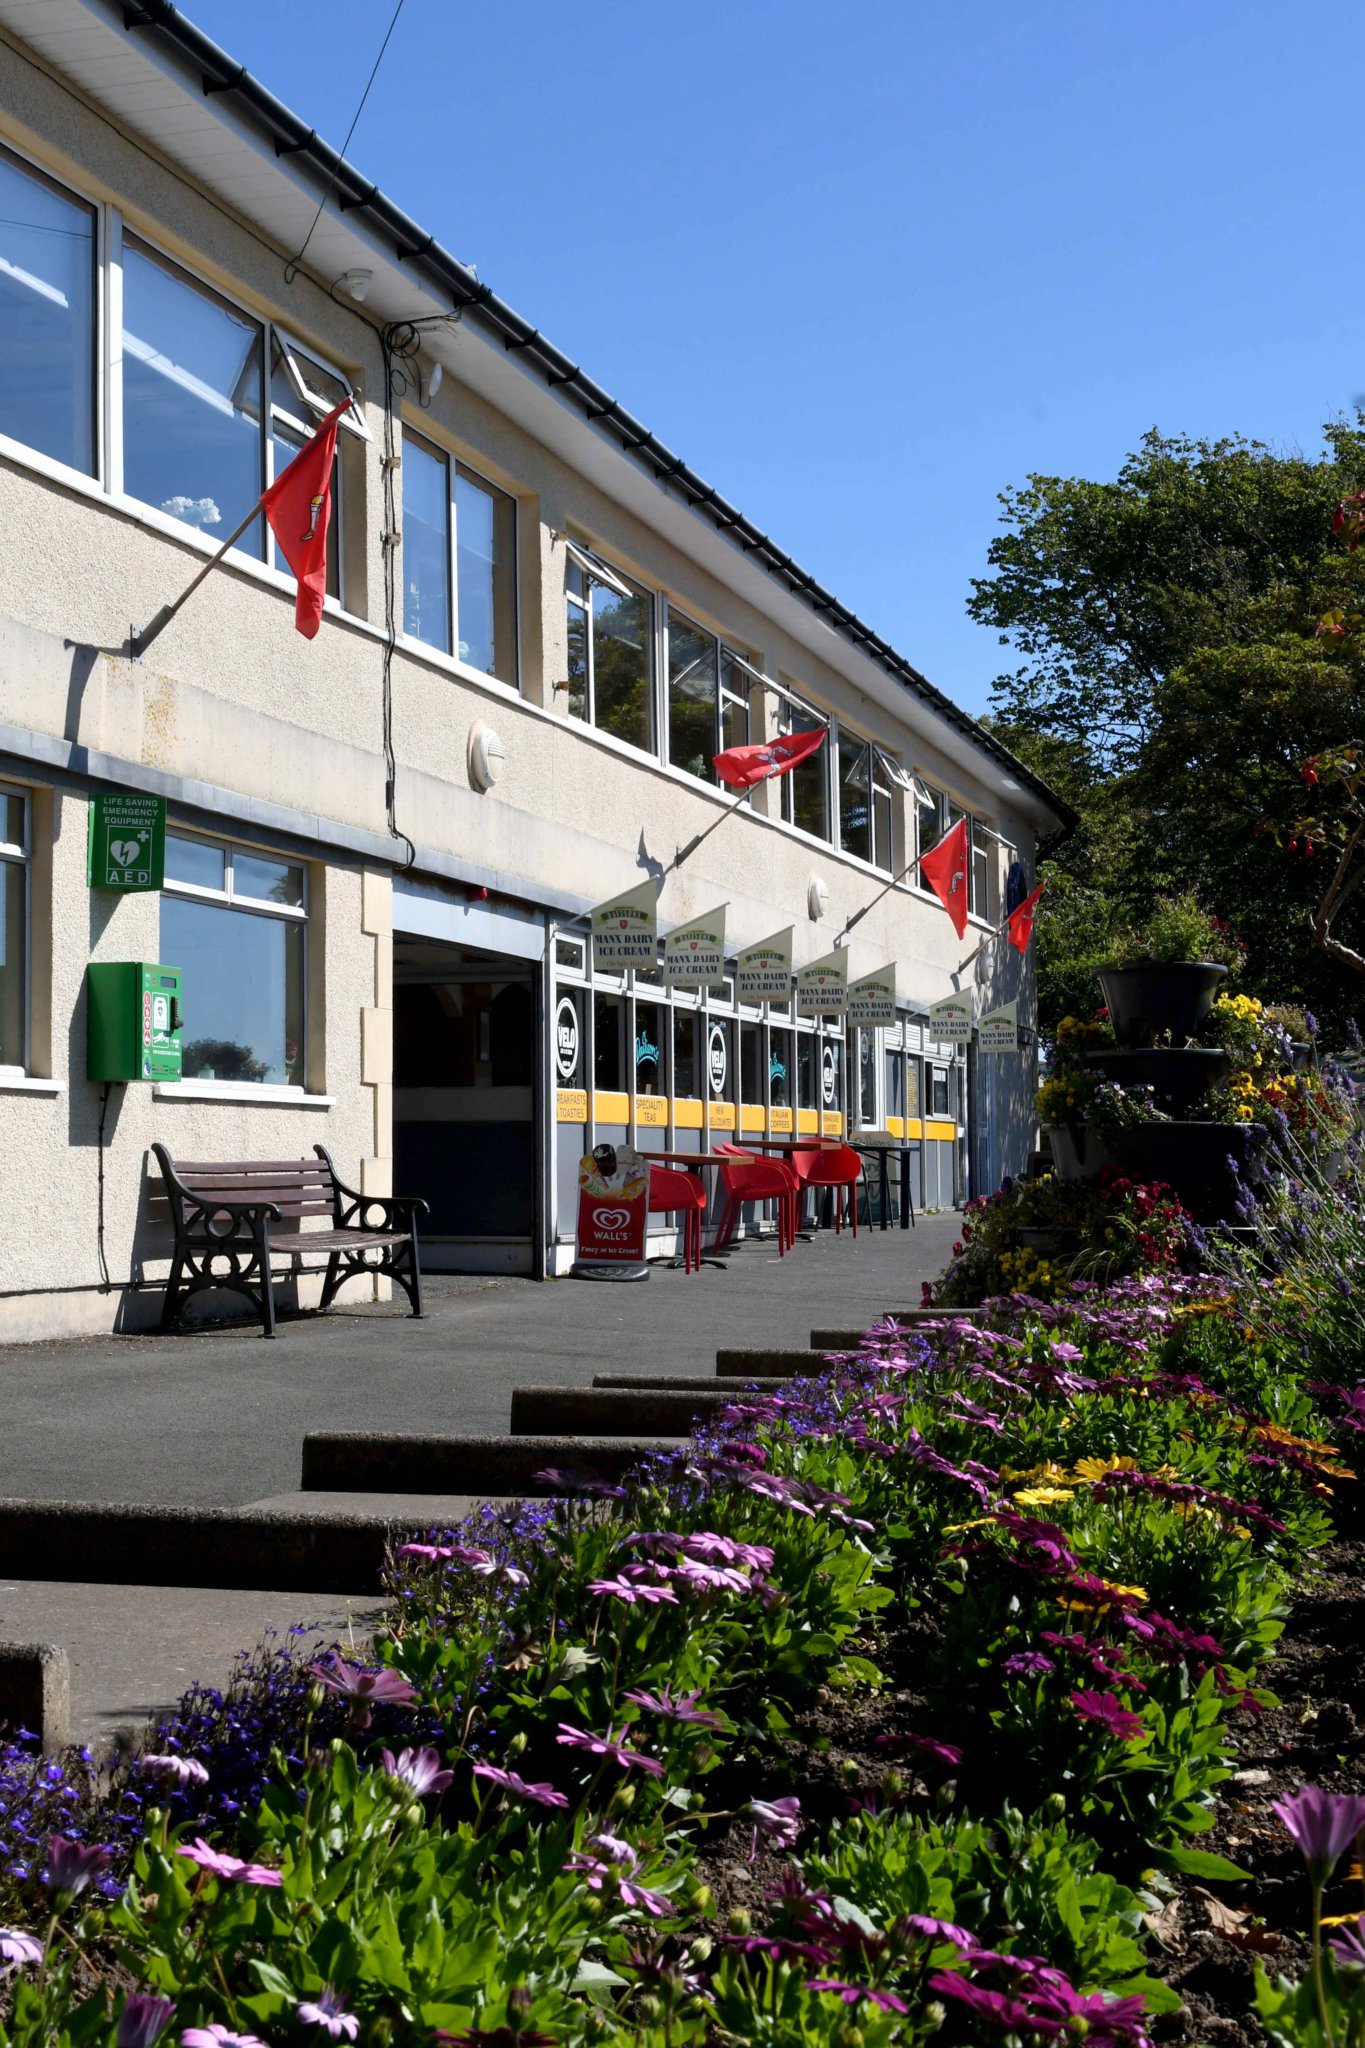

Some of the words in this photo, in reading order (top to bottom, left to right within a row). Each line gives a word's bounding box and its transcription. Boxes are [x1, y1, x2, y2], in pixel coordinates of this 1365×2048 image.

[103, 797, 122, 805] LIFE
[125, 798, 158, 807] SAVING
[102, 807, 158, 817] EMERGENCY
[104, 816, 156, 826] EQUIPMENT
[595, 934, 622, 944] MANX
[624, 934, 653, 944] DAIRY
[599, 946, 616, 956] ICE
[617, 946, 650, 956] CREAM
[667, 955, 691, 964] MANX
[693, 954, 720, 963] DAIRY
[669, 965, 683, 974] ICE
[685, 965, 718, 974] CREAM
[740, 972, 761, 981] MANX
[763, 972, 788, 980] DAIRY
[742, 982, 756, 991] ICE
[757, 982, 786, 990] CREAM
[799, 988, 819, 996] MANX
[821, 988, 844, 996] DAIRY
[801, 997, 814, 1005] ICE
[815, 997, 842, 1005] CREAM
[557, 1026, 575, 1049] VELO
[711, 1050, 724, 1069] VELO
[636, 1099, 663, 1110] SPECIALITY
[559, 1107, 584, 1119] TOASTIES
[644, 1112, 656, 1122] TEAS
[593, 1231, 628, 1241] WALL'S
[581, 1246, 598, 1254] Fancy
